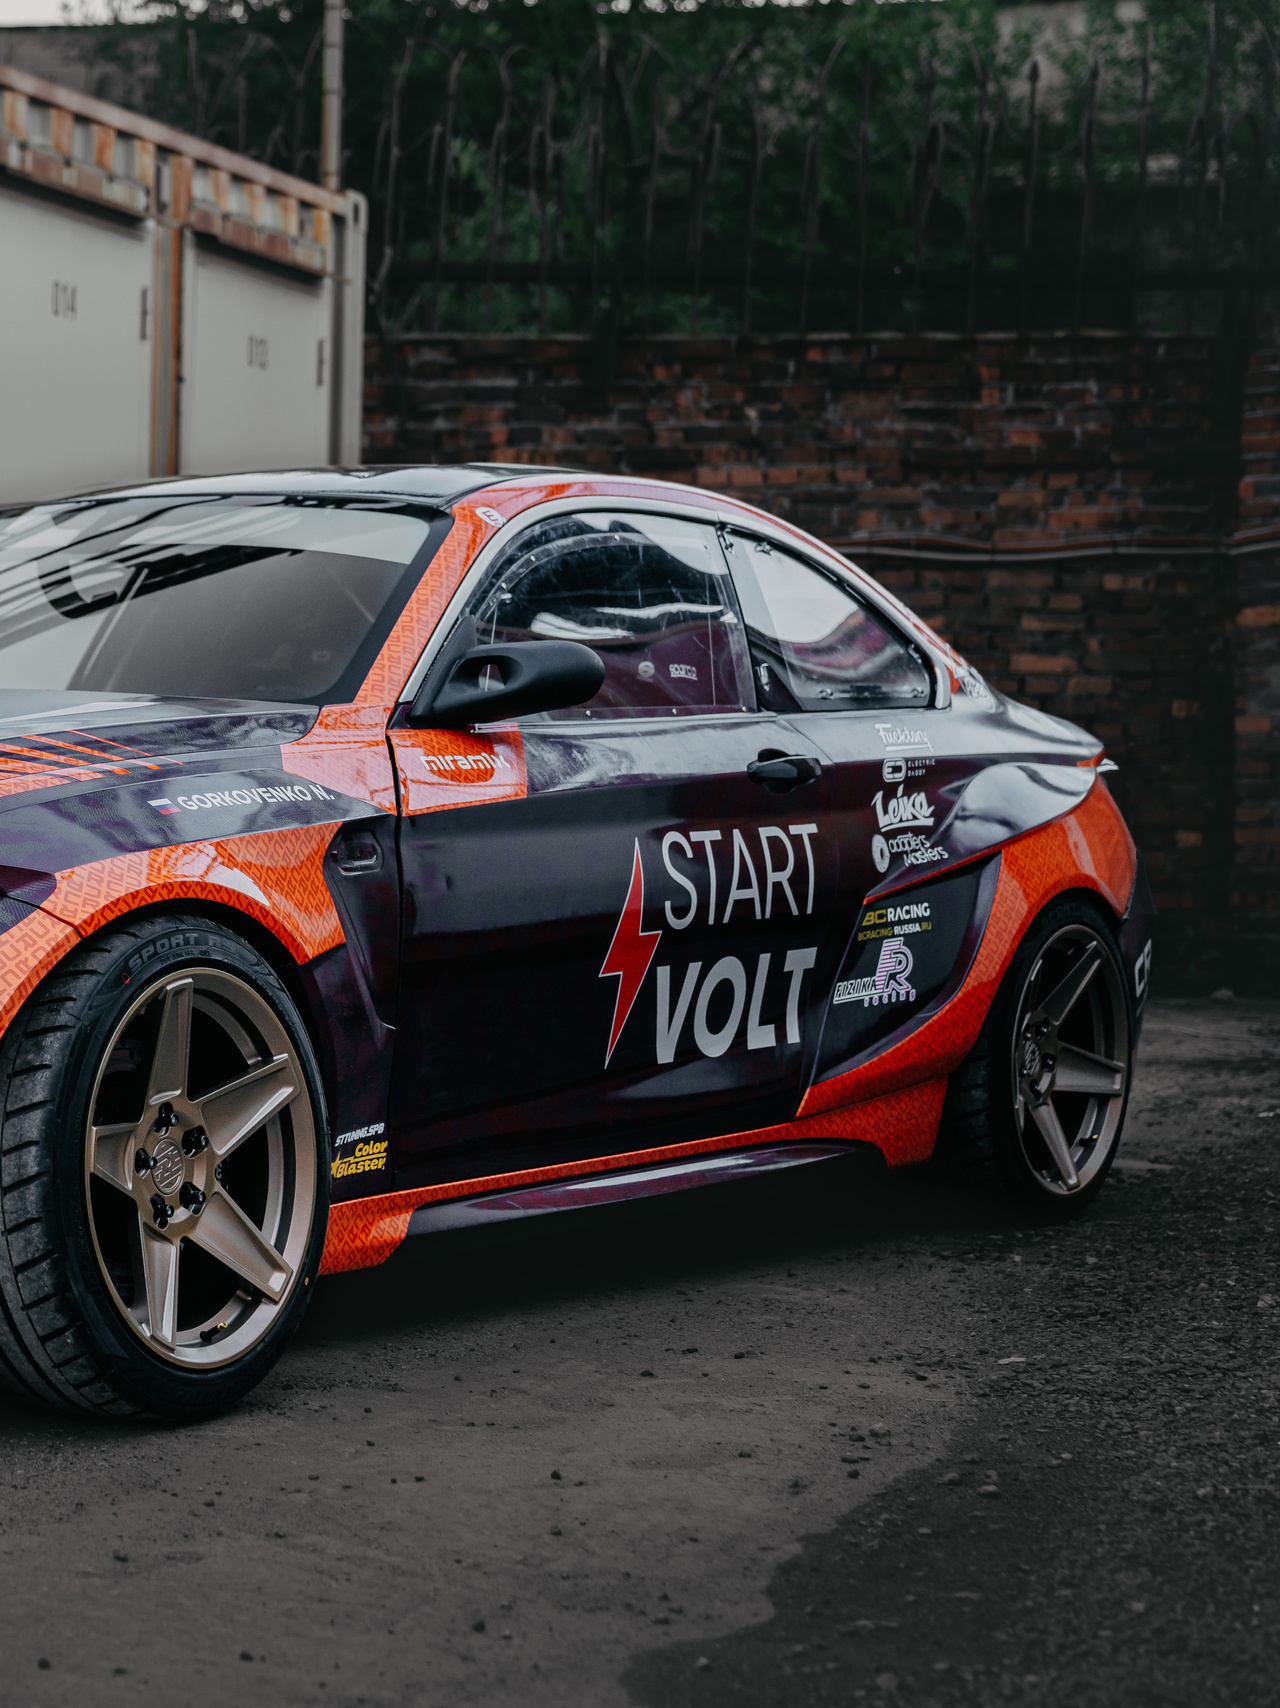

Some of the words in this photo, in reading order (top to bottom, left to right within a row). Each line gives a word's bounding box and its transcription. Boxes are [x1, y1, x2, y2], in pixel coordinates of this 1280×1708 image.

[176, 785, 313, 811] GORKOVENKO
[308, 784, 336, 801] N.
[871, 784, 935, 829] Leika
[661, 823, 818, 930] START
[128, 933, 199, 972] SPORT
[656, 947, 818, 1065] VOLT
[336, 1157, 387, 1179] Blaster
[355, 1140, 388, 1158] Color
